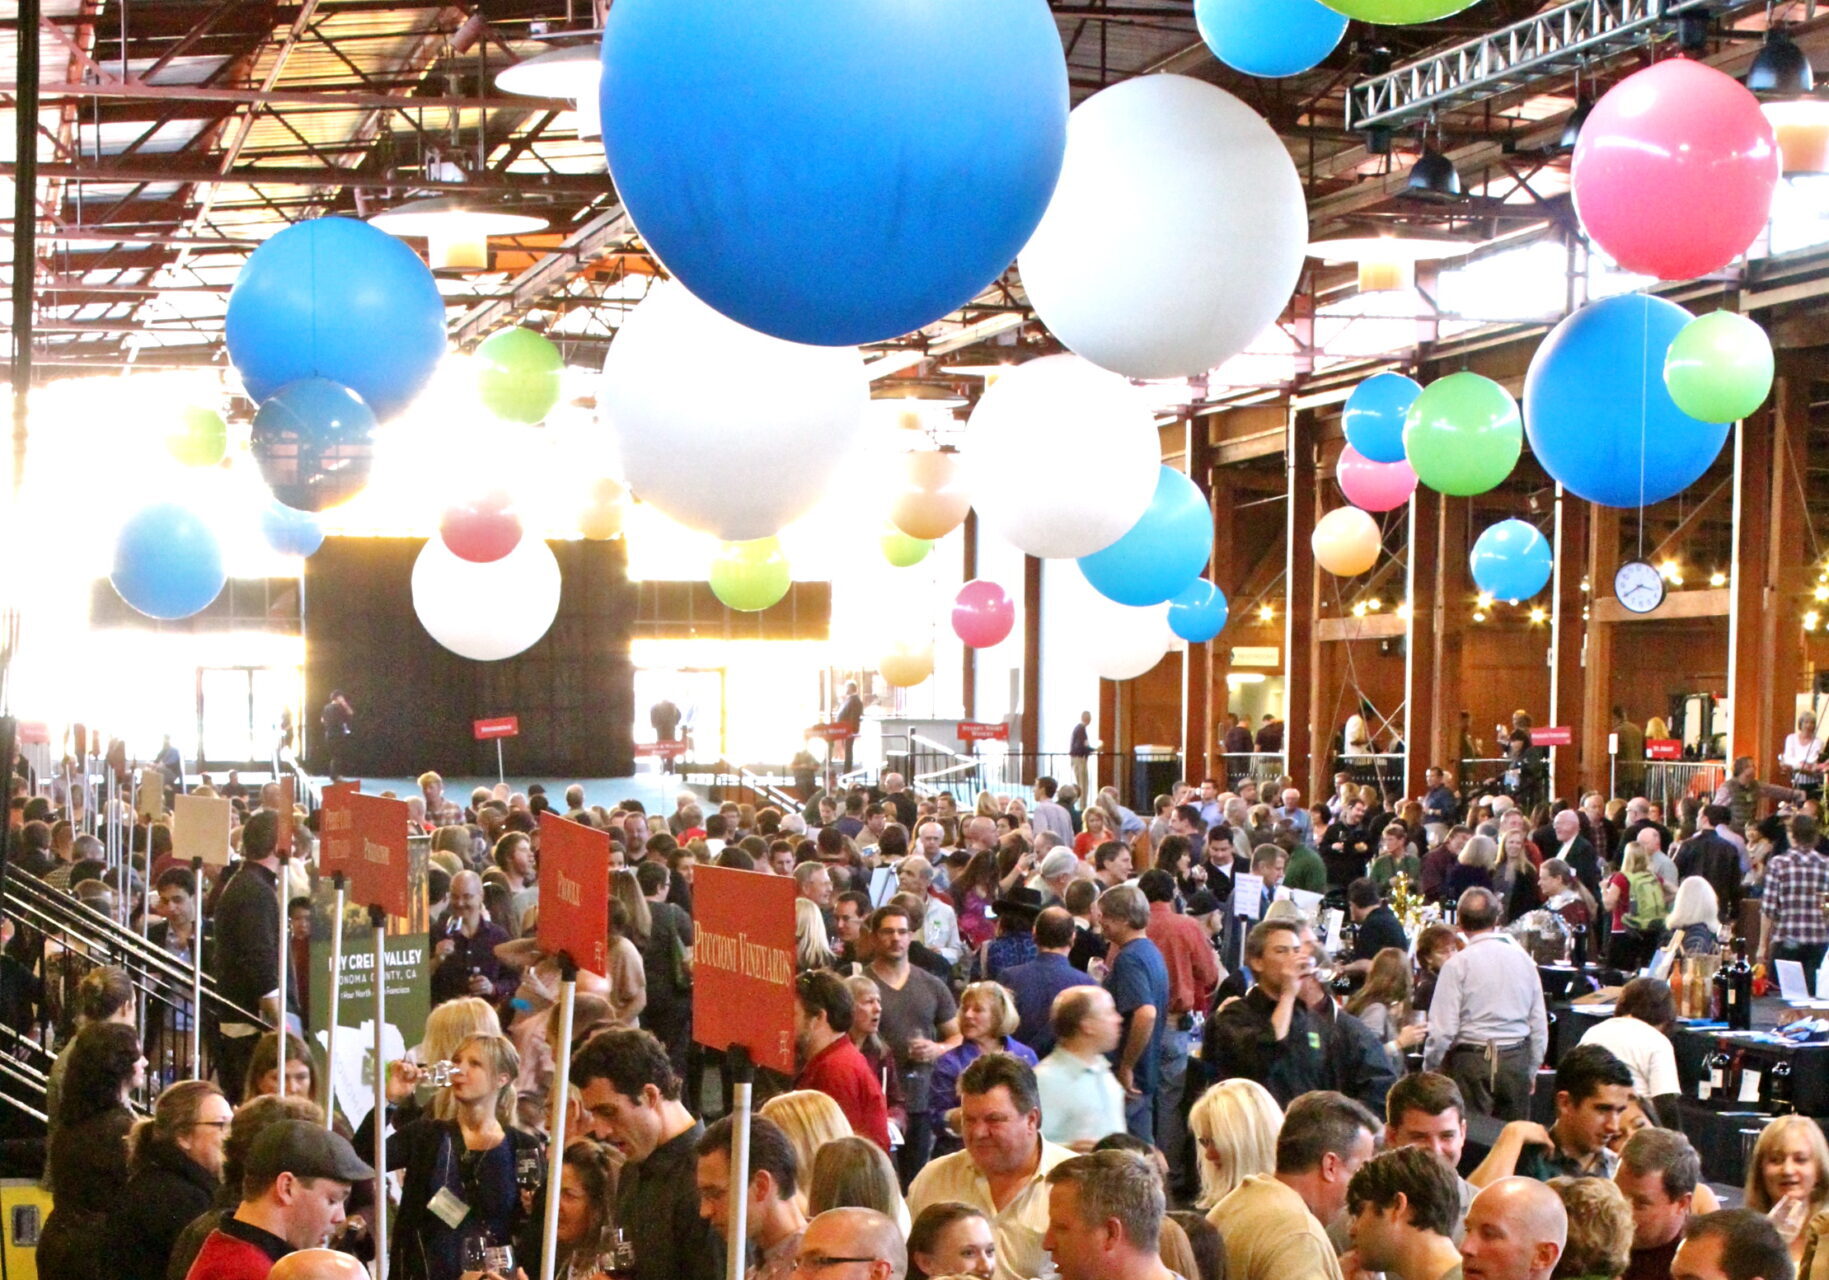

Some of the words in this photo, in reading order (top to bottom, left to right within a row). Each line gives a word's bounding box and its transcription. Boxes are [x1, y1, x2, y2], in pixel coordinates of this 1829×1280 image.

[348, 952, 375, 970] CRE
[384, 949, 423, 967] VALLEY
[693, 920, 737, 973] PUCCIONI
[738, 932, 791, 986] VINEYARDS
[339, 973, 367, 986] ONOMA
[405, 969, 417, 980] CA
[355, 989, 371, 998] North
